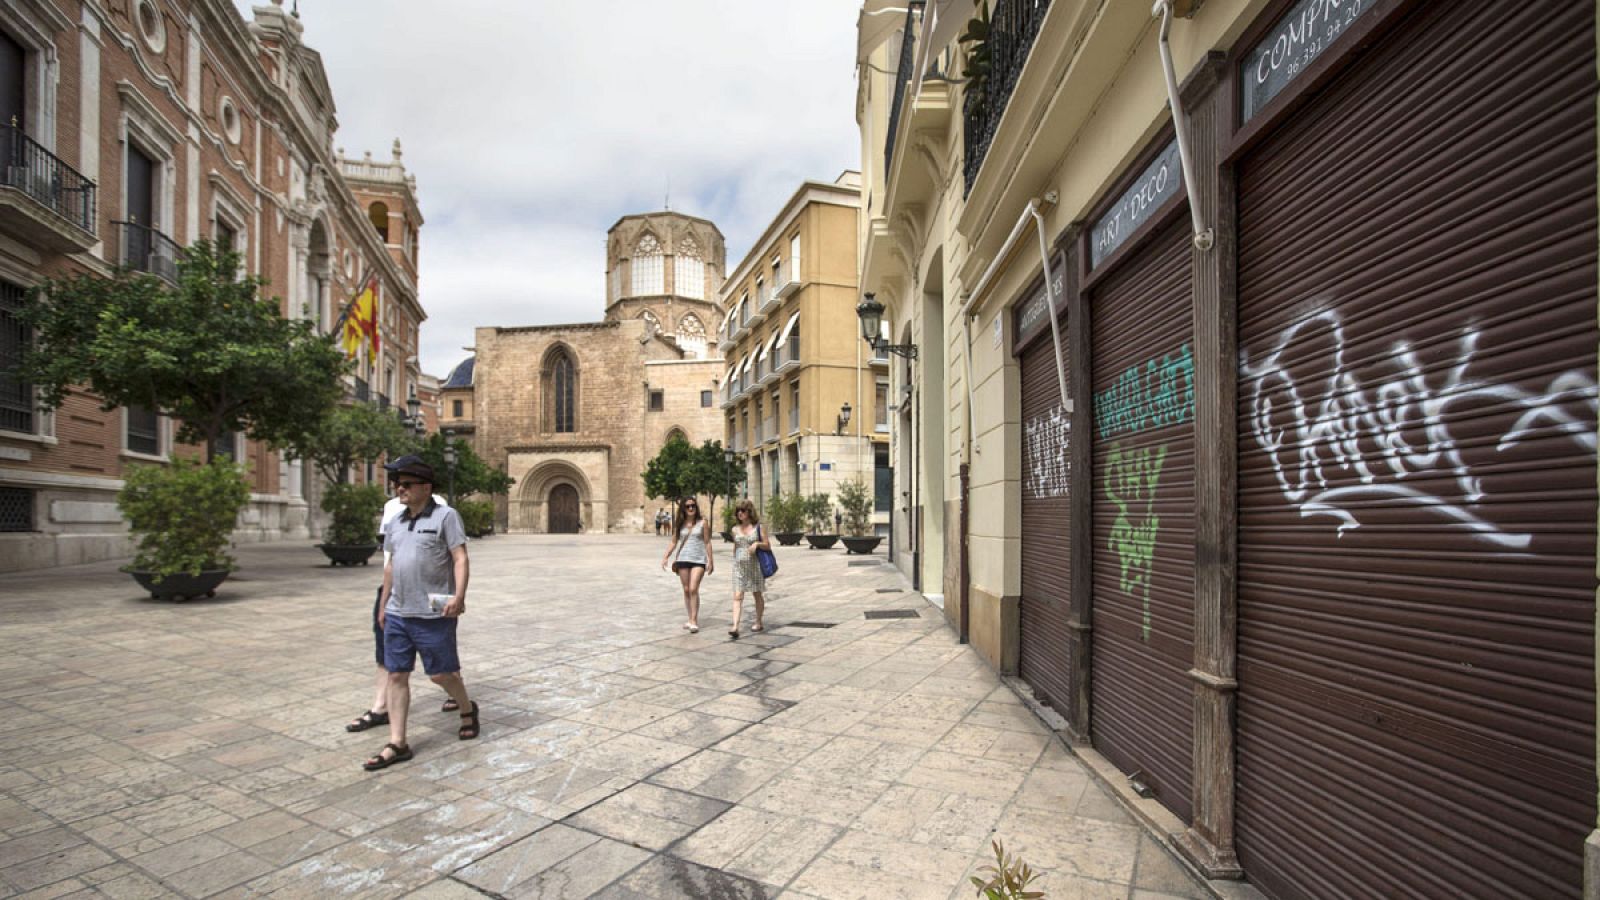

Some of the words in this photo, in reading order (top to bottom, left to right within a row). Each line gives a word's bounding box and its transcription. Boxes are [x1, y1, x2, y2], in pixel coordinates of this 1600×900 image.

[1287, 57, 1299, 80] 96
[1303, 37, 1321, 65] 391
[1344, 0, 1361, 25] 20
